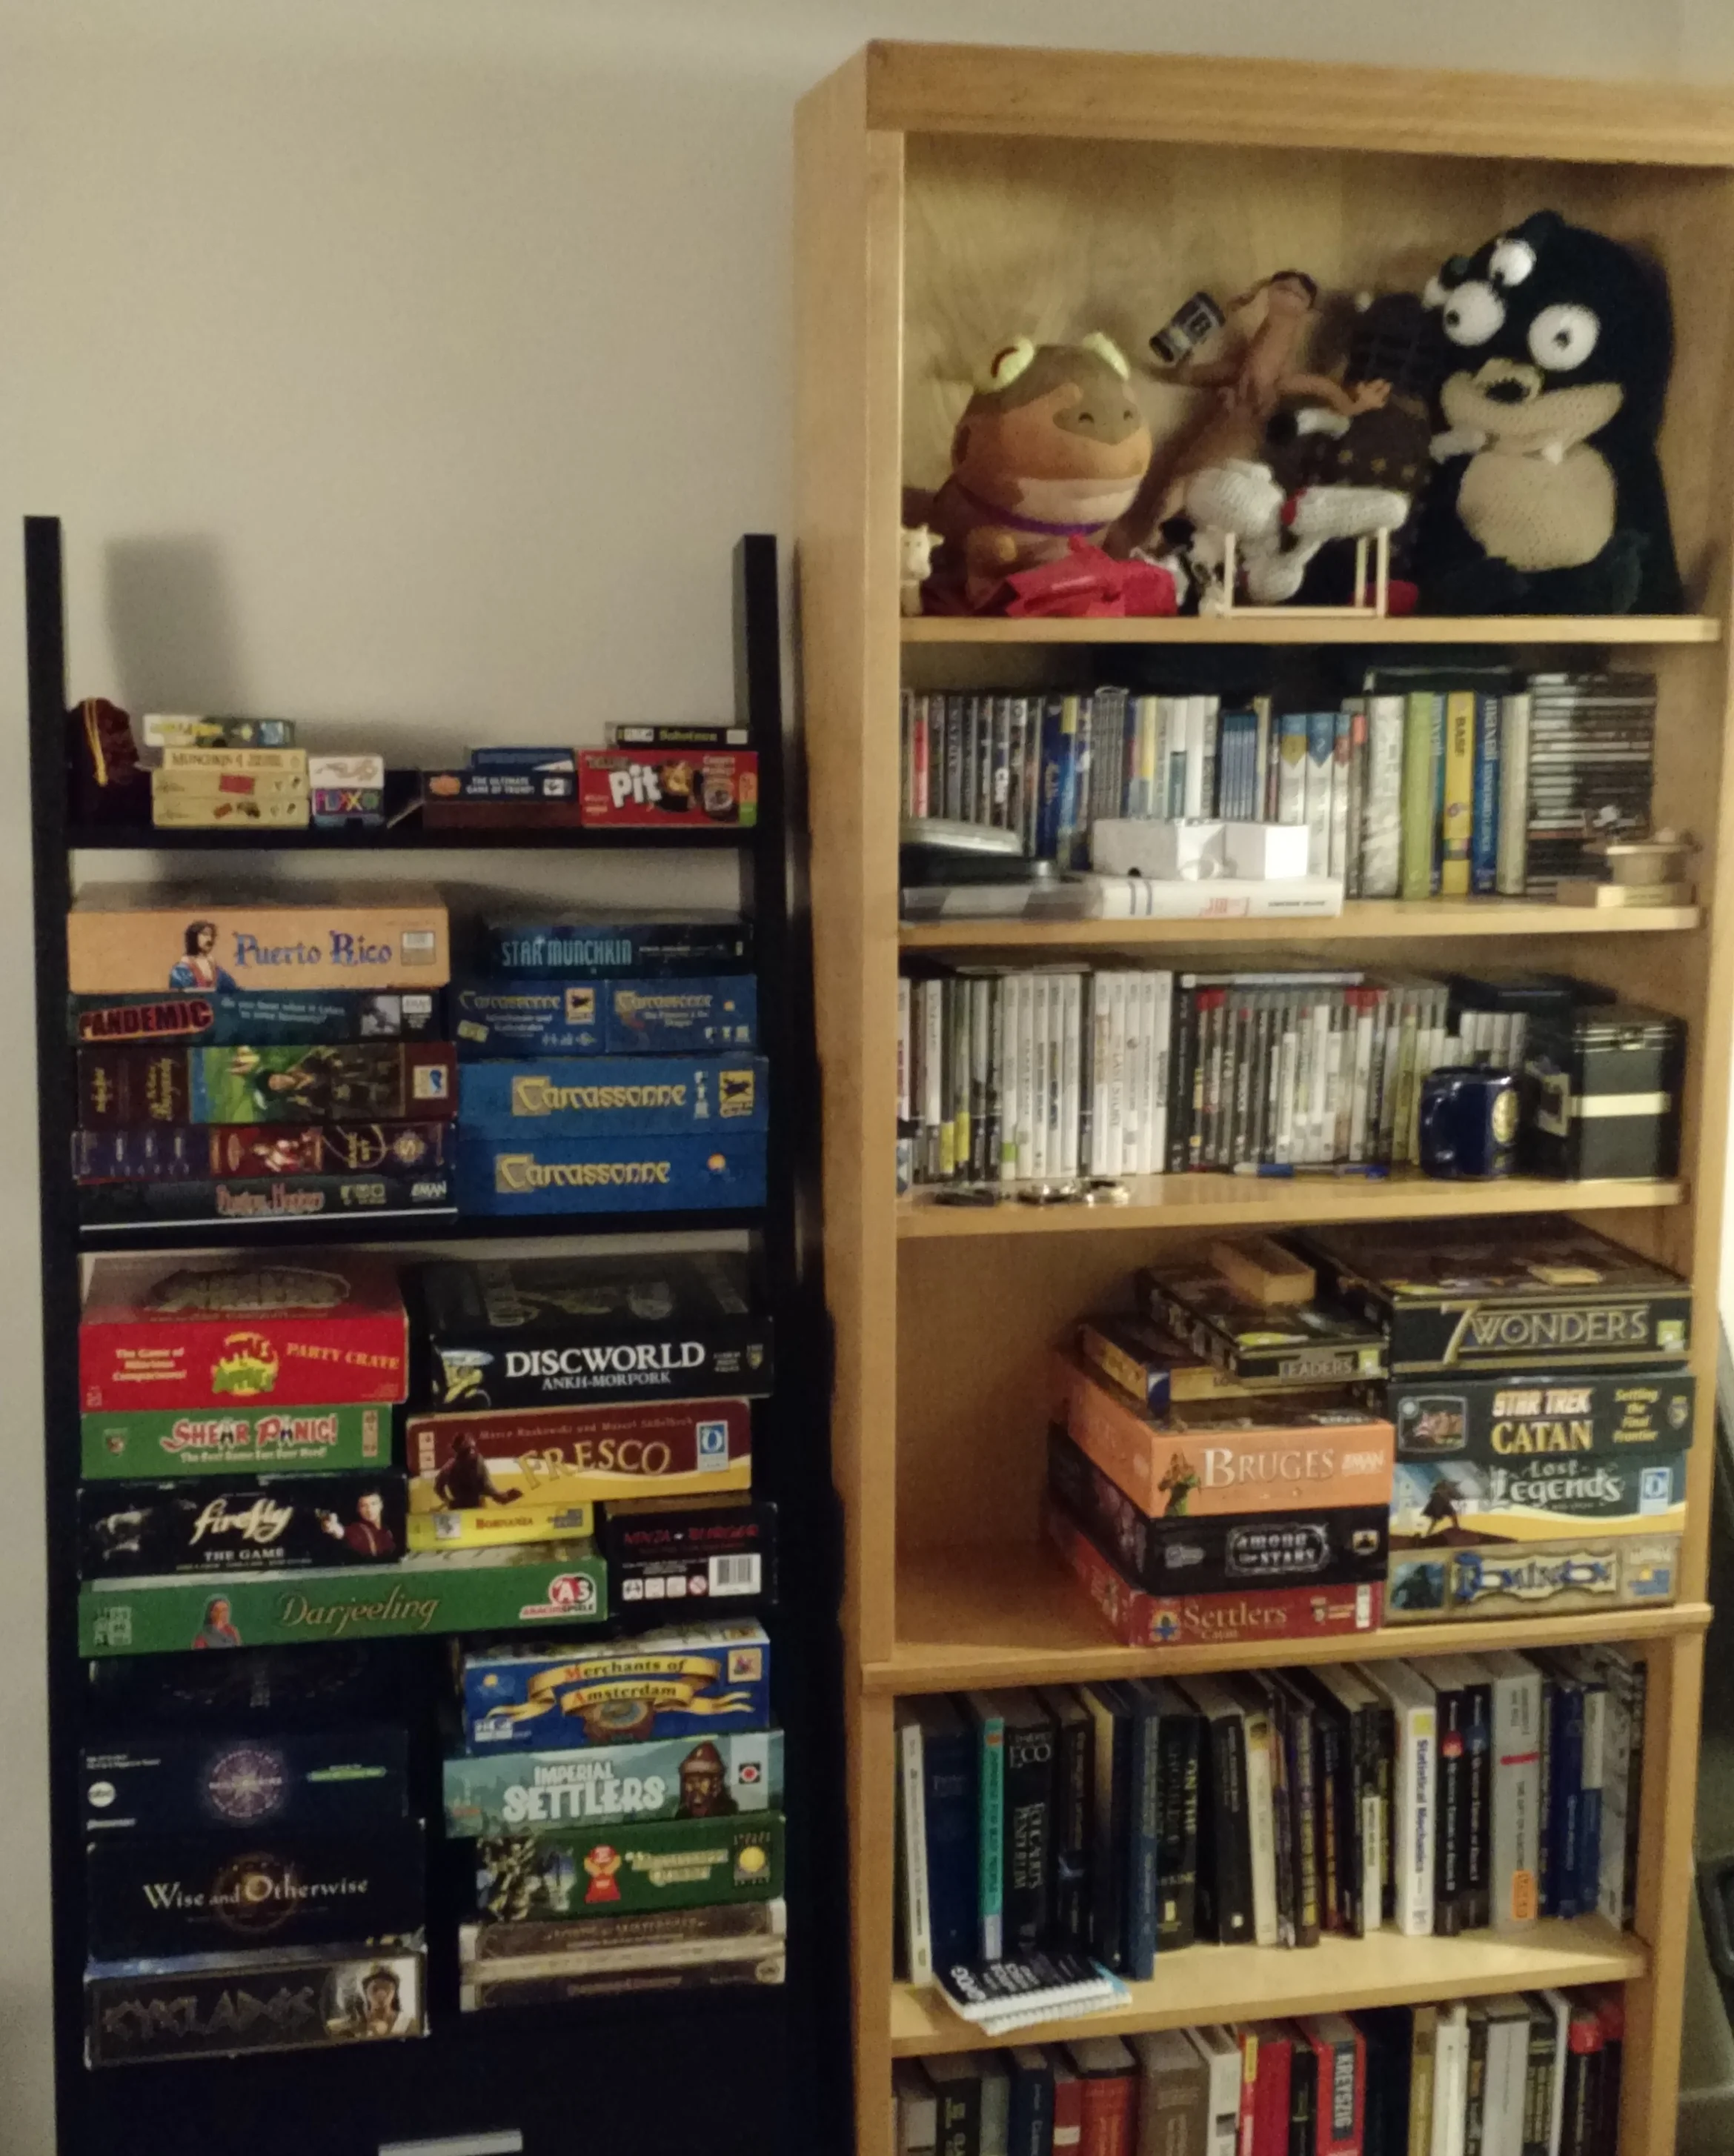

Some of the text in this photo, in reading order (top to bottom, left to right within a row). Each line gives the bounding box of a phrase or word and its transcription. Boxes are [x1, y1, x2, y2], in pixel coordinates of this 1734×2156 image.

[1455, 716, 1467, 757] BASF
[232, 930, 392, 968] Puerto Rico
[502, 939, 632, 966] STAR MUNCHKIN
[79, 1000, 213, 1037] PANDEMIC
[516, 1077, 687, 1111] Carcassonne
[499, 1155, 671, 1189] Carcassonne
[1440, 1300, 1650, 1365] 7 WONDERS
[286, 1342, 400, 1370] PARTY CRATE
[505, 1341, 706, 1378] DISCWORLD
[1280, 1357, 1353, 1383] LEADERS
[542, 1371, 672, 1391] ANKH-MORPORK
[1492, 1387, 1595, 1417] STAR TREK
[160, 1413, 339, 1453] SHEAR PANIC!
[1491, 1420, 1595, 1455] CATAN
[518, 1439, 671, 1491] FRESCO
[1203, 1447, 1335, 1488] BRUGES
[1529, 1460, 1579, 1480] Lost
[1490, 1465, 1625, 1508] Legends
[188, 1496, 294, 1545] firefly
[204, 1547, 285, 1562] THE GAME
[279, 1586, 440, 1635] Darjeeling
[1184, 1597, 1288, 1628] Settlers
[564, 1659, 687, 1681] Merchants of
[571, 1685, 678, 1704] Amsterdam
[534, 1760, 614, 1786] IMPERIAL
[502, 1775, 668, 1823] SETTLERS
[1415, 1739, 1429, 1874] Statistical Mechanics
[143, 1873, 369, 1910] Wise and Otherwise
[1333, 2053, 1355, 2129] KREYSZIG
